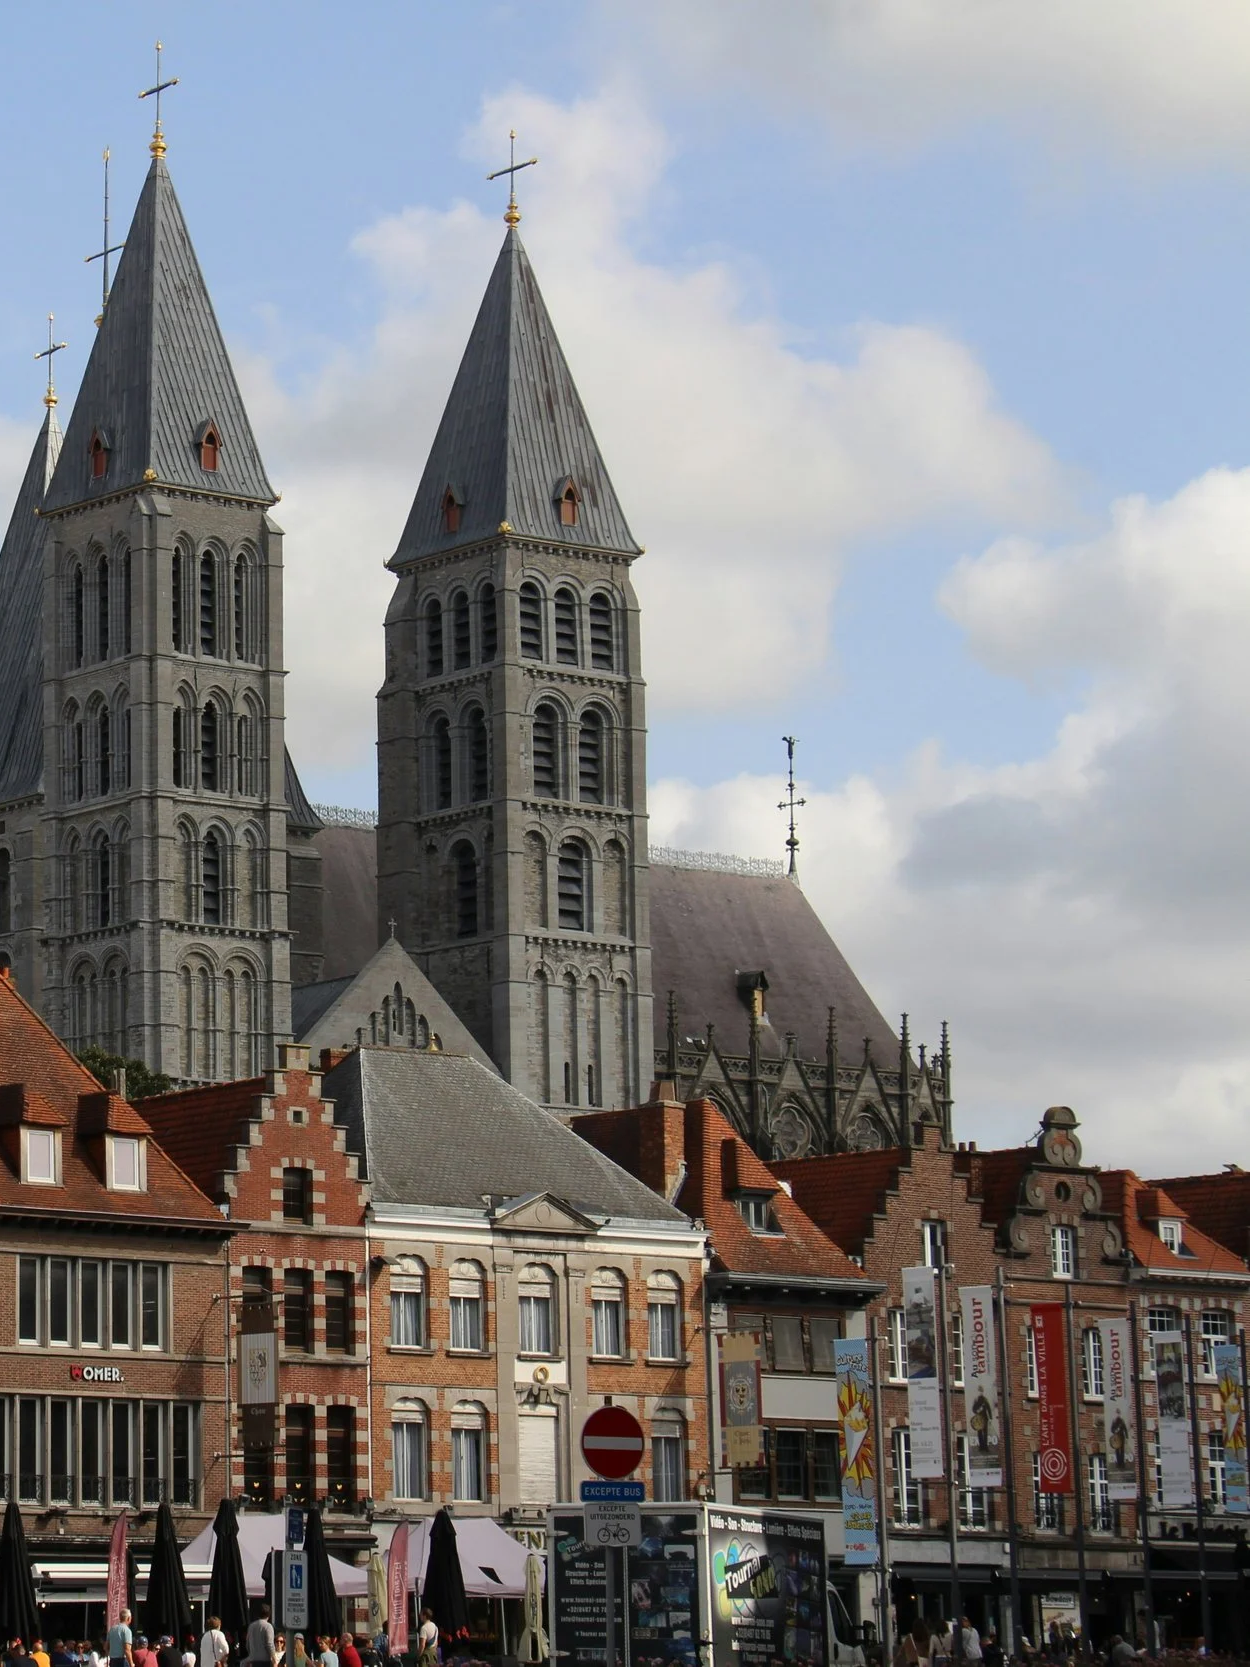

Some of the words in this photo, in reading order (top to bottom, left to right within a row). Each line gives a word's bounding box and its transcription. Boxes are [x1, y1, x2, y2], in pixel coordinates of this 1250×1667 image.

[972, 1297, 986, 1374] tambour
[1036, 1332, 1046, 1362] VILLE
[1039, 1366, 1047, 1380] LA
[1110, 1329, 1123, 1398] tambour
[1041, 1419, 1049, 1446] L'ART
[584, 1487, 623, 1496] EXCEPTE
[624, 1487, 641, 1496] BUS
[590, 1513, 636, 1521] UITGEZONDERD
[710, 1514, 724, 1529] Vidéo
[727, 1516, 738, 1530] Son
[741, 1518, 763, 1533] Structure
[586, 1578, 607, 1586] Spéciau
[725, 1556, 761, 1593] Tournai
